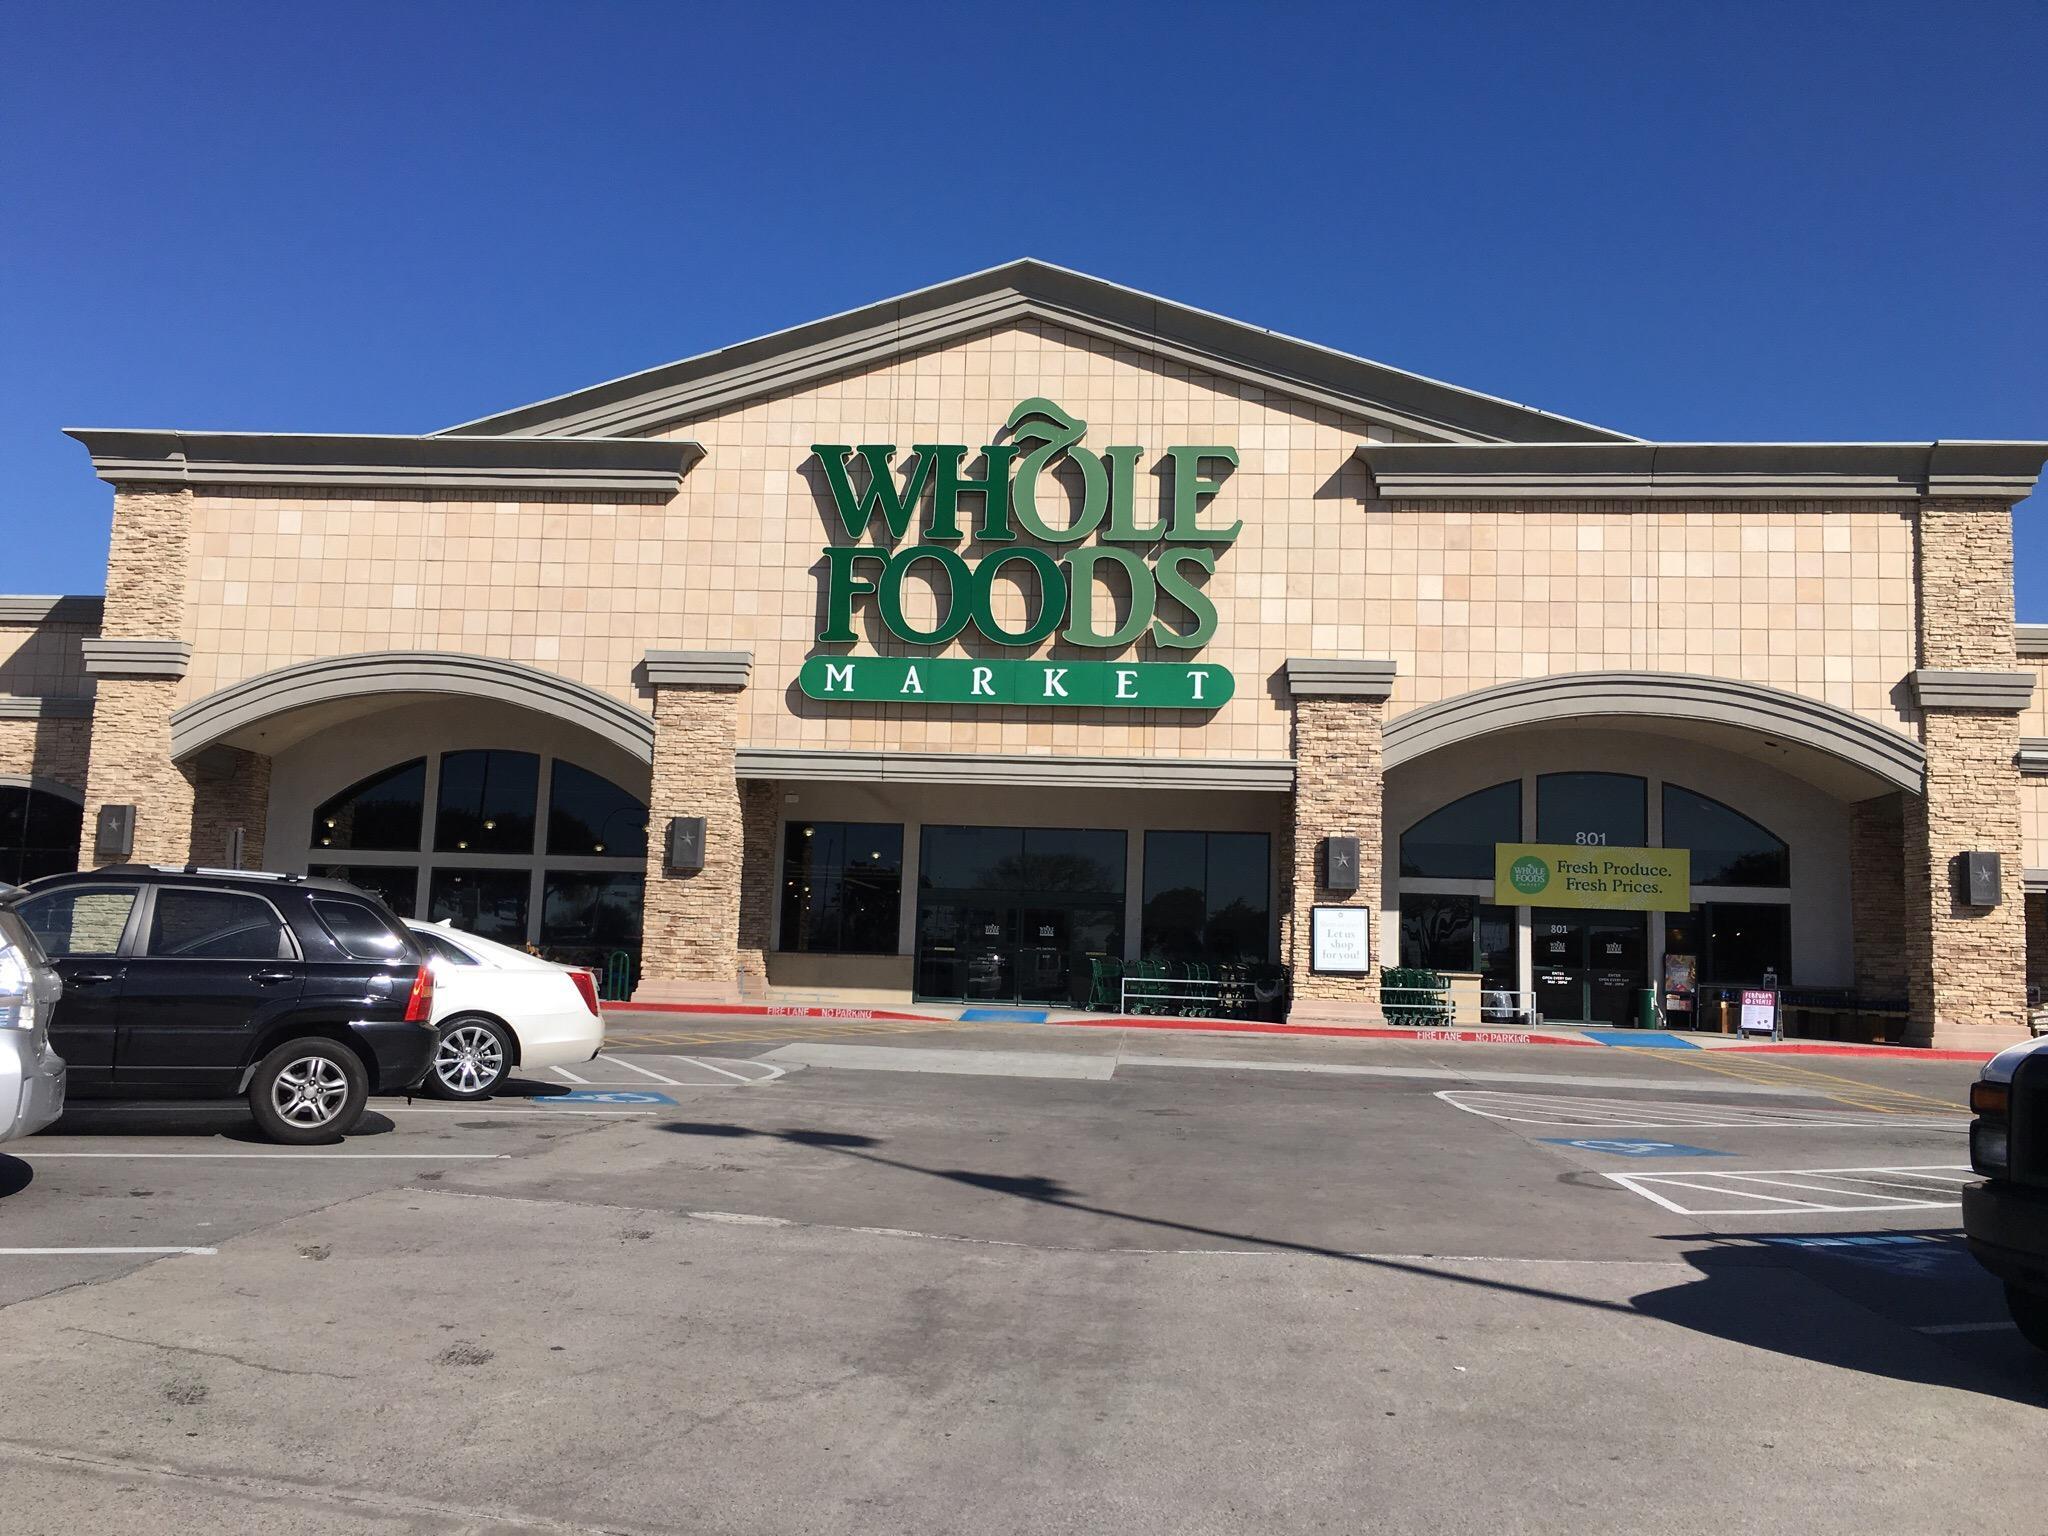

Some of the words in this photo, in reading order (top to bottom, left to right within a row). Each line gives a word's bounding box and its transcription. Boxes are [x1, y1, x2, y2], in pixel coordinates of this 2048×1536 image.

[811, 397, 1243, 543] WHOLE
[818, 545, 1218, 649] FOODS
[824, 663, 1209, 700] MARKET
[1575, 831, 1607, 846] 801
[1514, 863, 1545, 875] WHOLE
[1557, 860, 1598, 874] Fresh
[1603, 862, 1672, 877] Produce.
[1566, 878, 1607, 892] Fresh
[1612, 880, 1662, 894] Prices.
[1327, 929, 1343, 938] Let
[1344, 930, 1356, 939] us
[1550, 925, 1568, 934] 801
[1330, 940, 1354, 951] shop
[1322, 949, 1337, 960] for
[1337, 950, 1360, 961] you!
[767, 1006, 785, 1016] FIRE
[787, 1007, 809, 1017] LANE
[821, 1008, 834, 1018] NO
[836, 1009, 873, 1019] PARKING
[1417, 1031, 1436, 1040] FIRE
[1438, 1032, 1462, 1041] LANE
[1475, 1033, 1489, 1042] NO
[1490, 1034, 1530, 1043] PARKING
